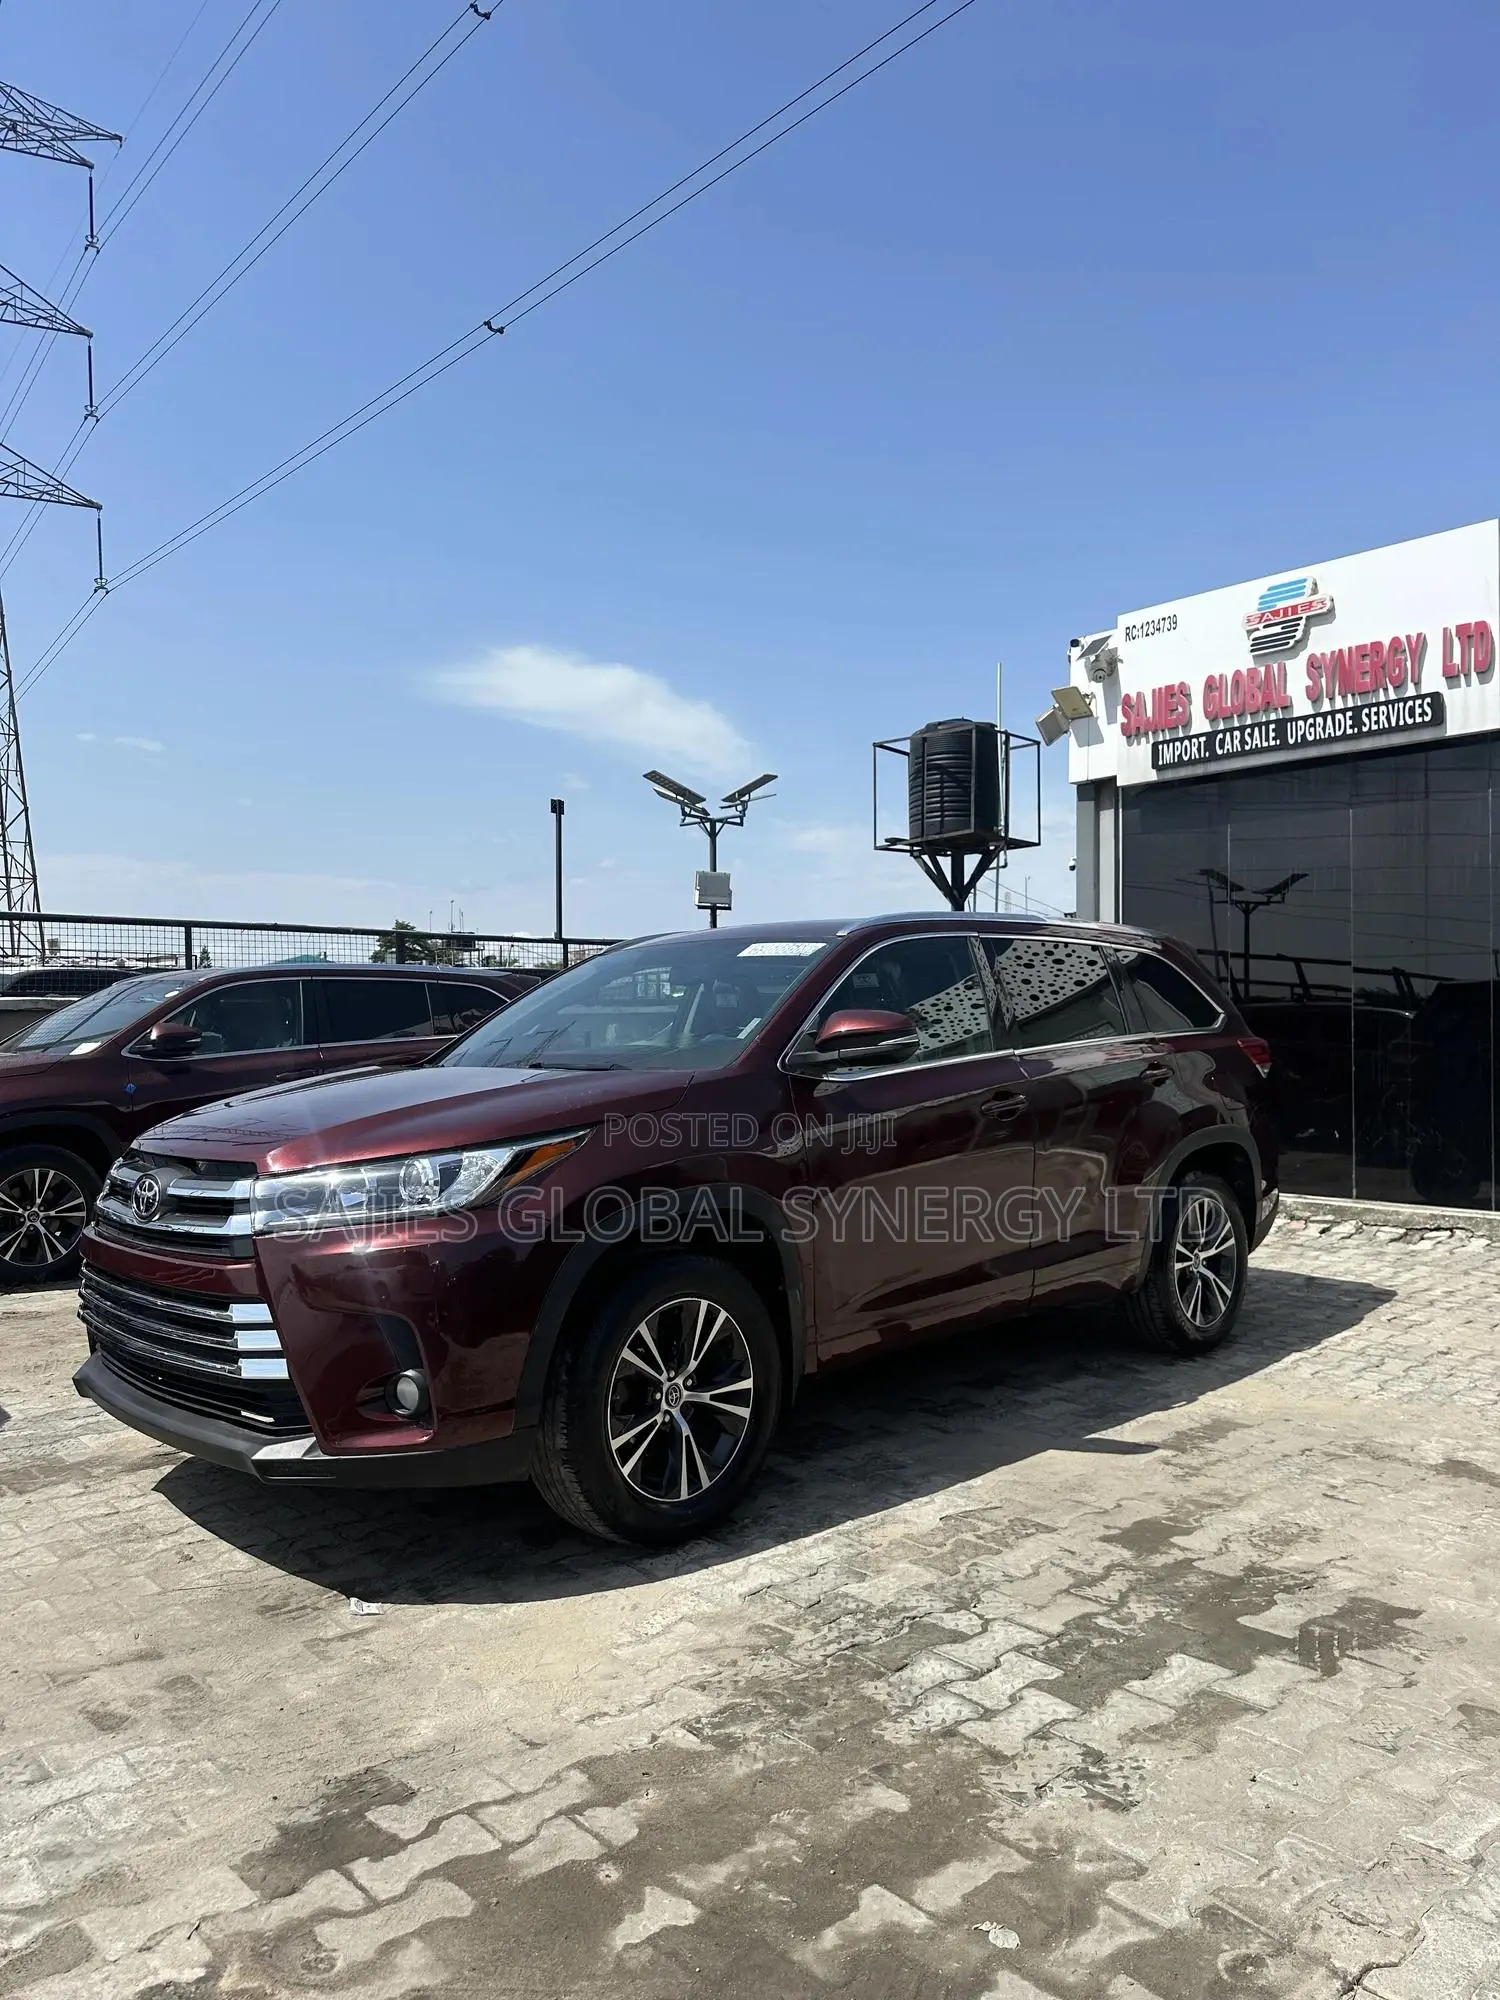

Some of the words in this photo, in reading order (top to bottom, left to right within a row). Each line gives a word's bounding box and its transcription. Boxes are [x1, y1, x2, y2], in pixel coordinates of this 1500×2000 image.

[1124, 614, 1178, 642] RC:1234739
[1244, 599, 1328, 626] SAJIES
[1121, 681, 1192, 737] SAJIES
[1203, 661, 1292, 720] GLOBAL
[1305, 632, 1426, 701] SYNERGY
[1442, 620, 1493, 678] LTD
[1158, 737, 1209, 766] IMPORT.
[1215, 730, 1241, 755] CAR
[1244, 723, 1280, 751] SALE.
[1287, 711, 1358, 745] UPGRADE.
[1361, 697, 1433, 732] SERVICES
